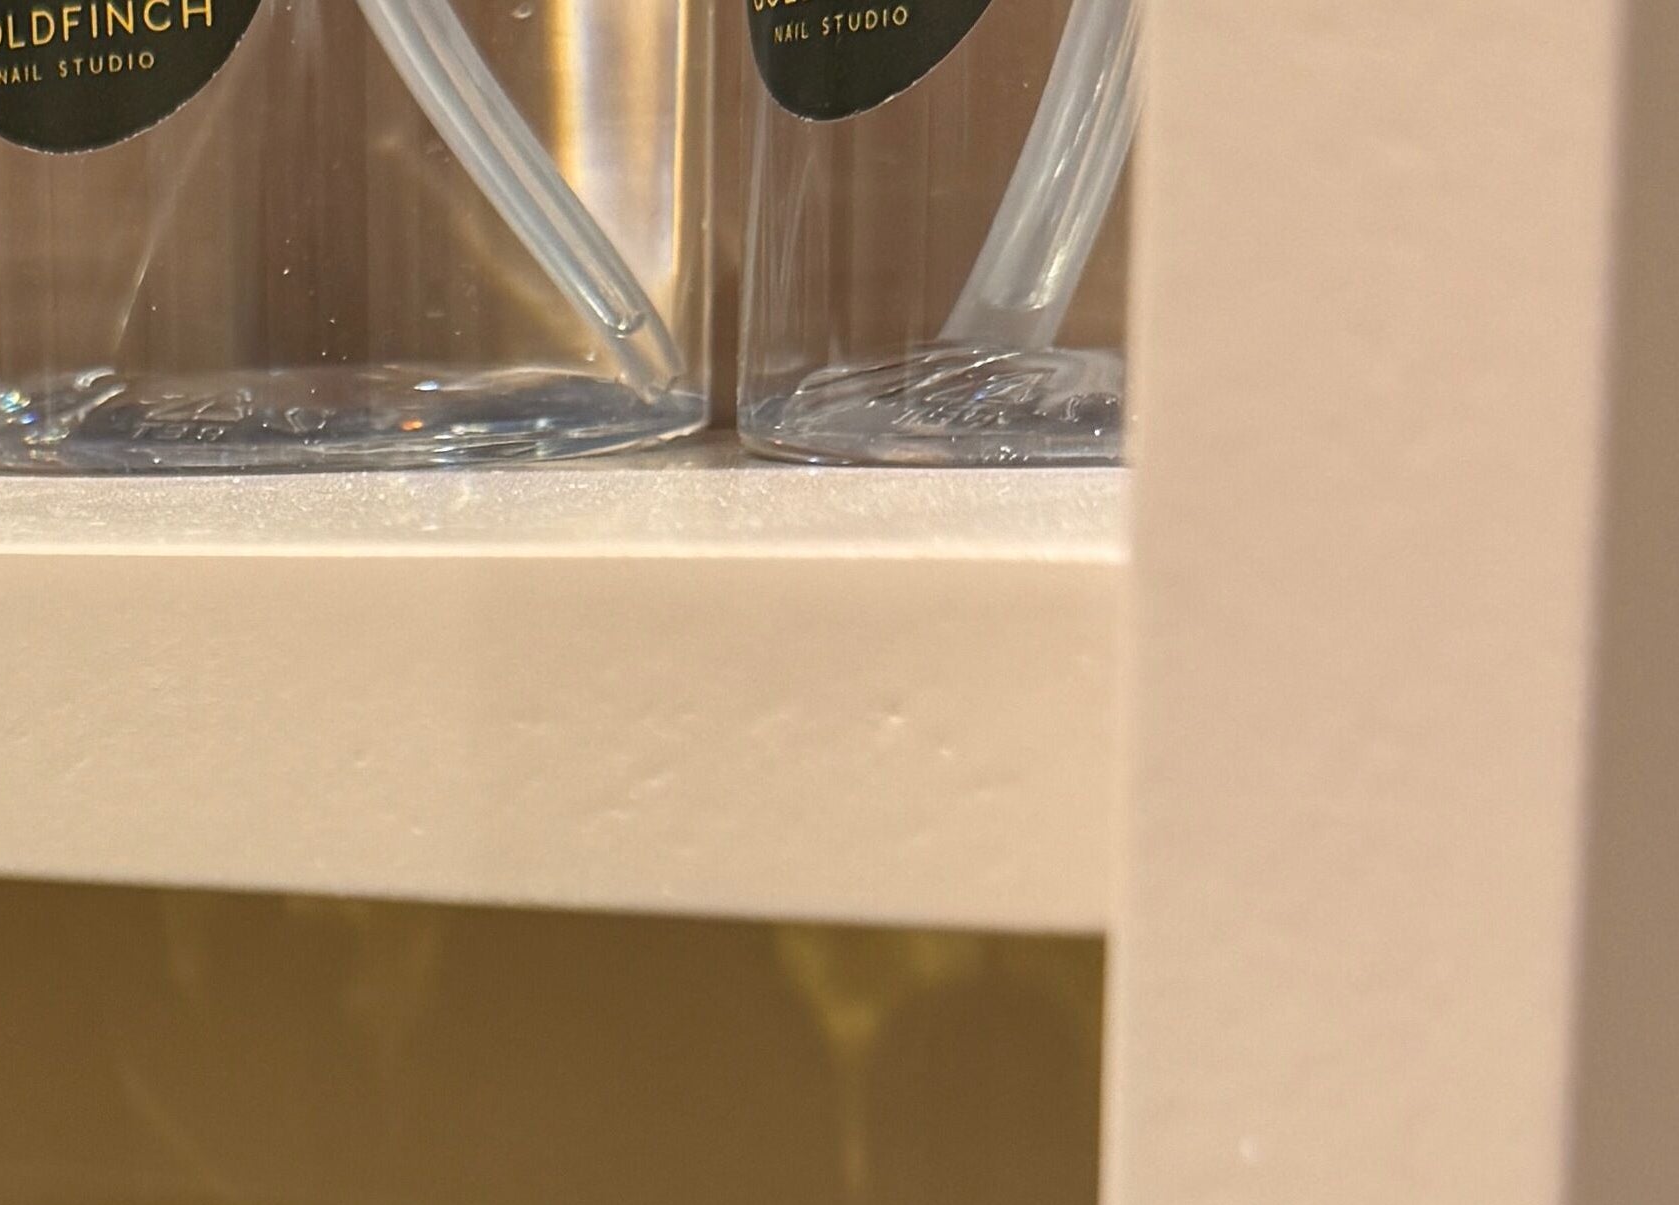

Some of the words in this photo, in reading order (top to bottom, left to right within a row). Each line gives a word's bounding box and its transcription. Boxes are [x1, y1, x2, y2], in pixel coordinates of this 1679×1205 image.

[774, 21, 809, 43] NAIL
[821, 5, 908, 36] STUDIO
[58, 51, 155, 78] STUDIO
